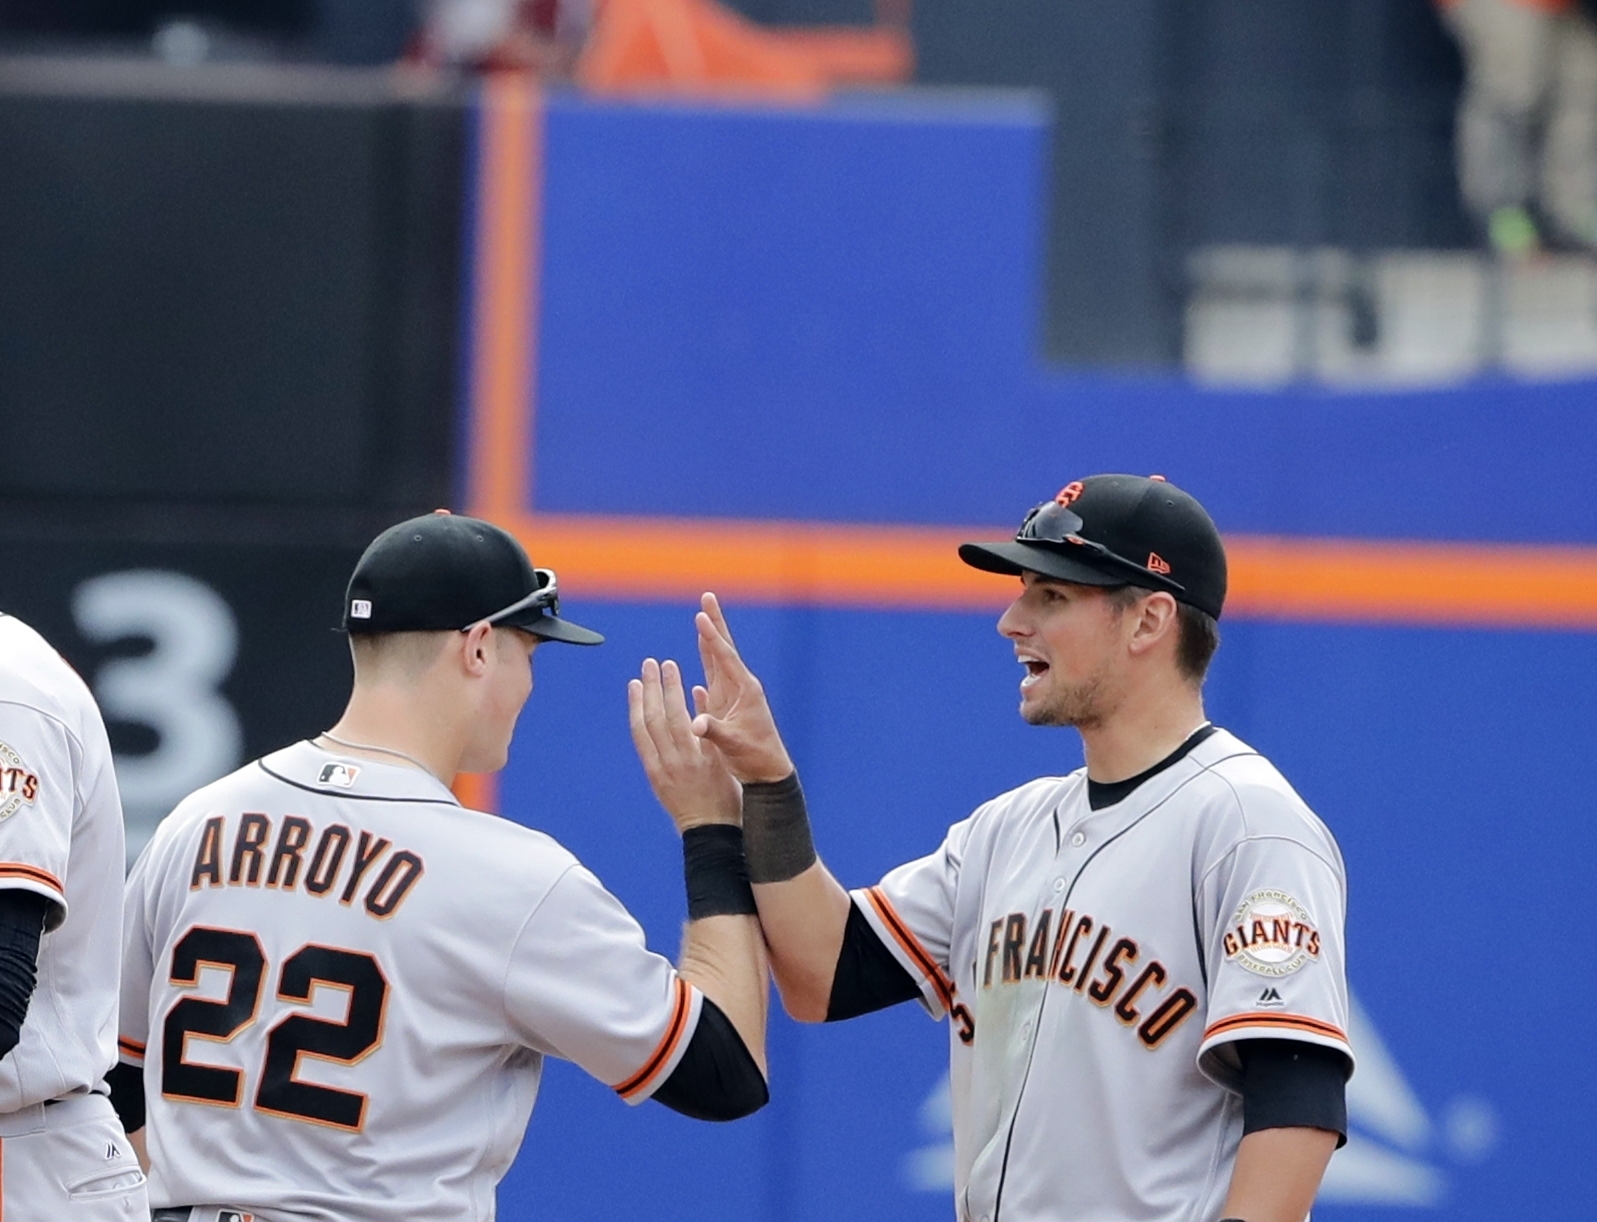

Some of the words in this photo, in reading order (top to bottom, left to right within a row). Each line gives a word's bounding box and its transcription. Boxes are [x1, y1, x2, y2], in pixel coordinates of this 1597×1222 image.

[191, 812, 425, 922] ARROYO
[1222, 918, 1321, 958] GIANTS
[161, 924, 391, 1134] 22
